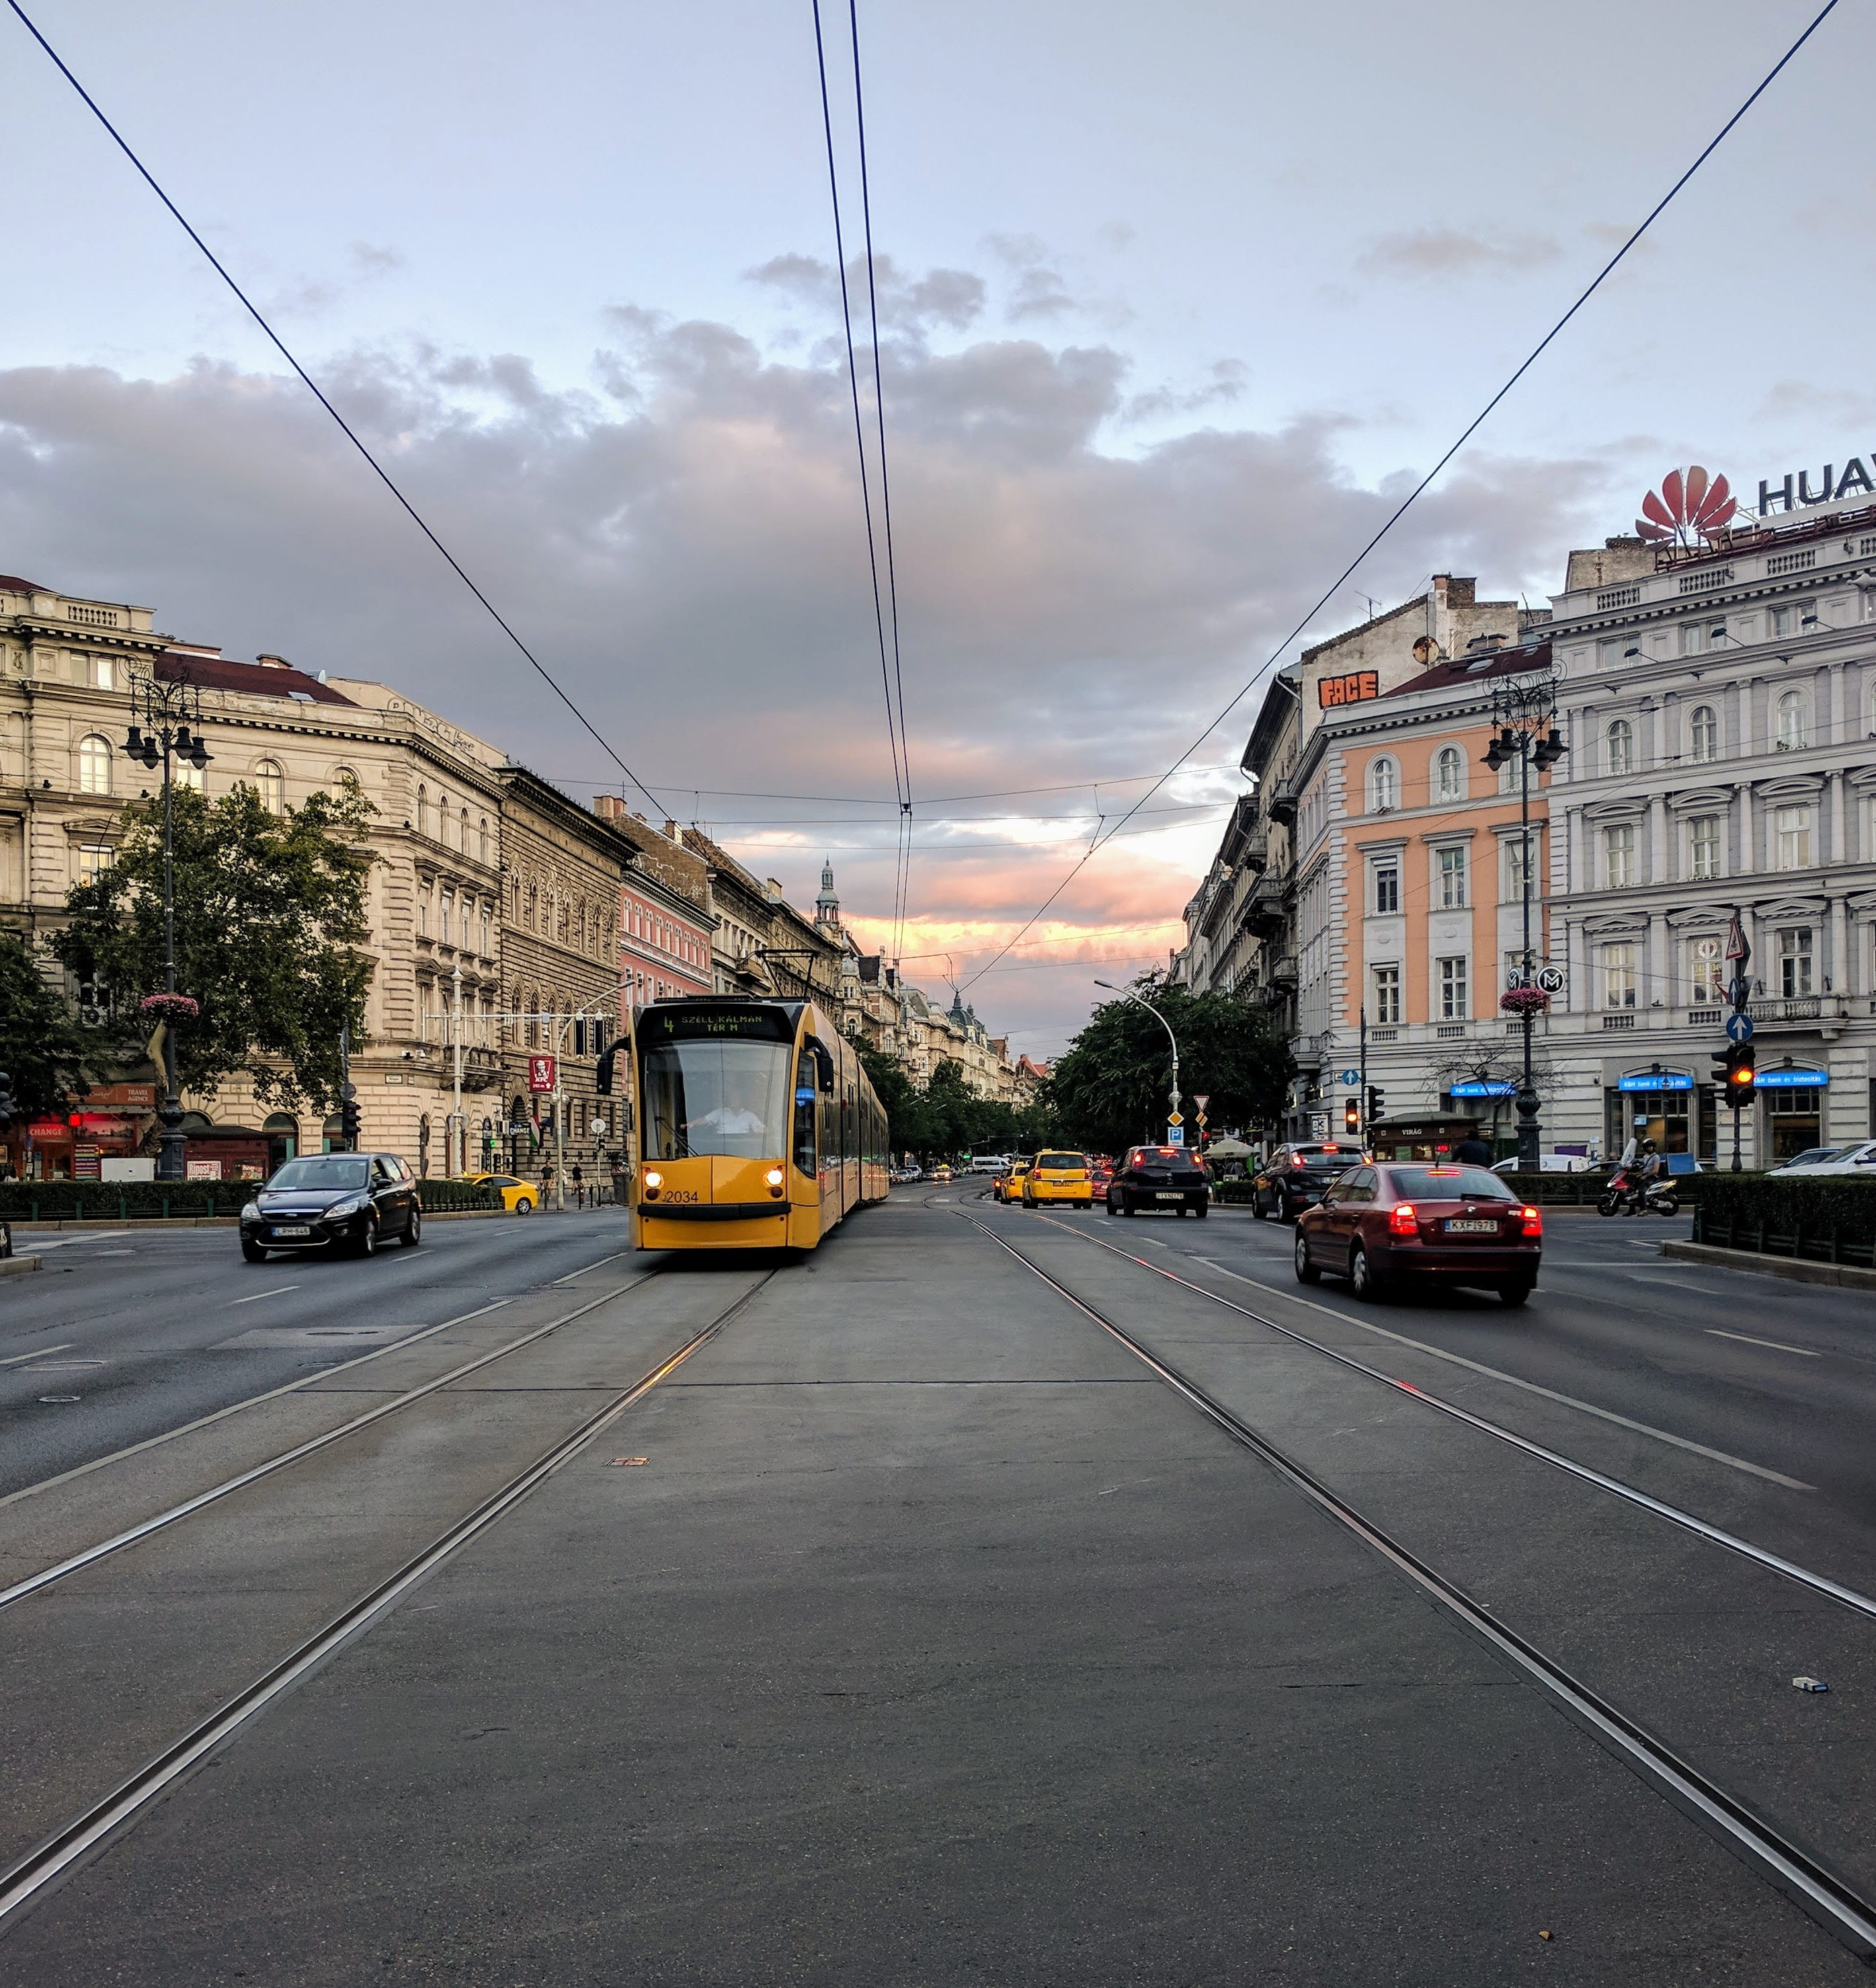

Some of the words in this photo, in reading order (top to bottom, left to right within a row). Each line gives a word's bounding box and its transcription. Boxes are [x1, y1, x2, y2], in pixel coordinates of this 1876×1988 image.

[1758, 453, 1876, 516] HUA
[1319, 671, 1378, 709] FACE
[1543, 971, 1560, 989] M
[664, 1016, 674, 1033] 4
[682, 1015, 715, 1023] SZÉLL
[509, 1127, 530, 1136] CHANGE
[1172, 1129, 1180, 1140] P
[666, 1191, 698, 1203] 2034
